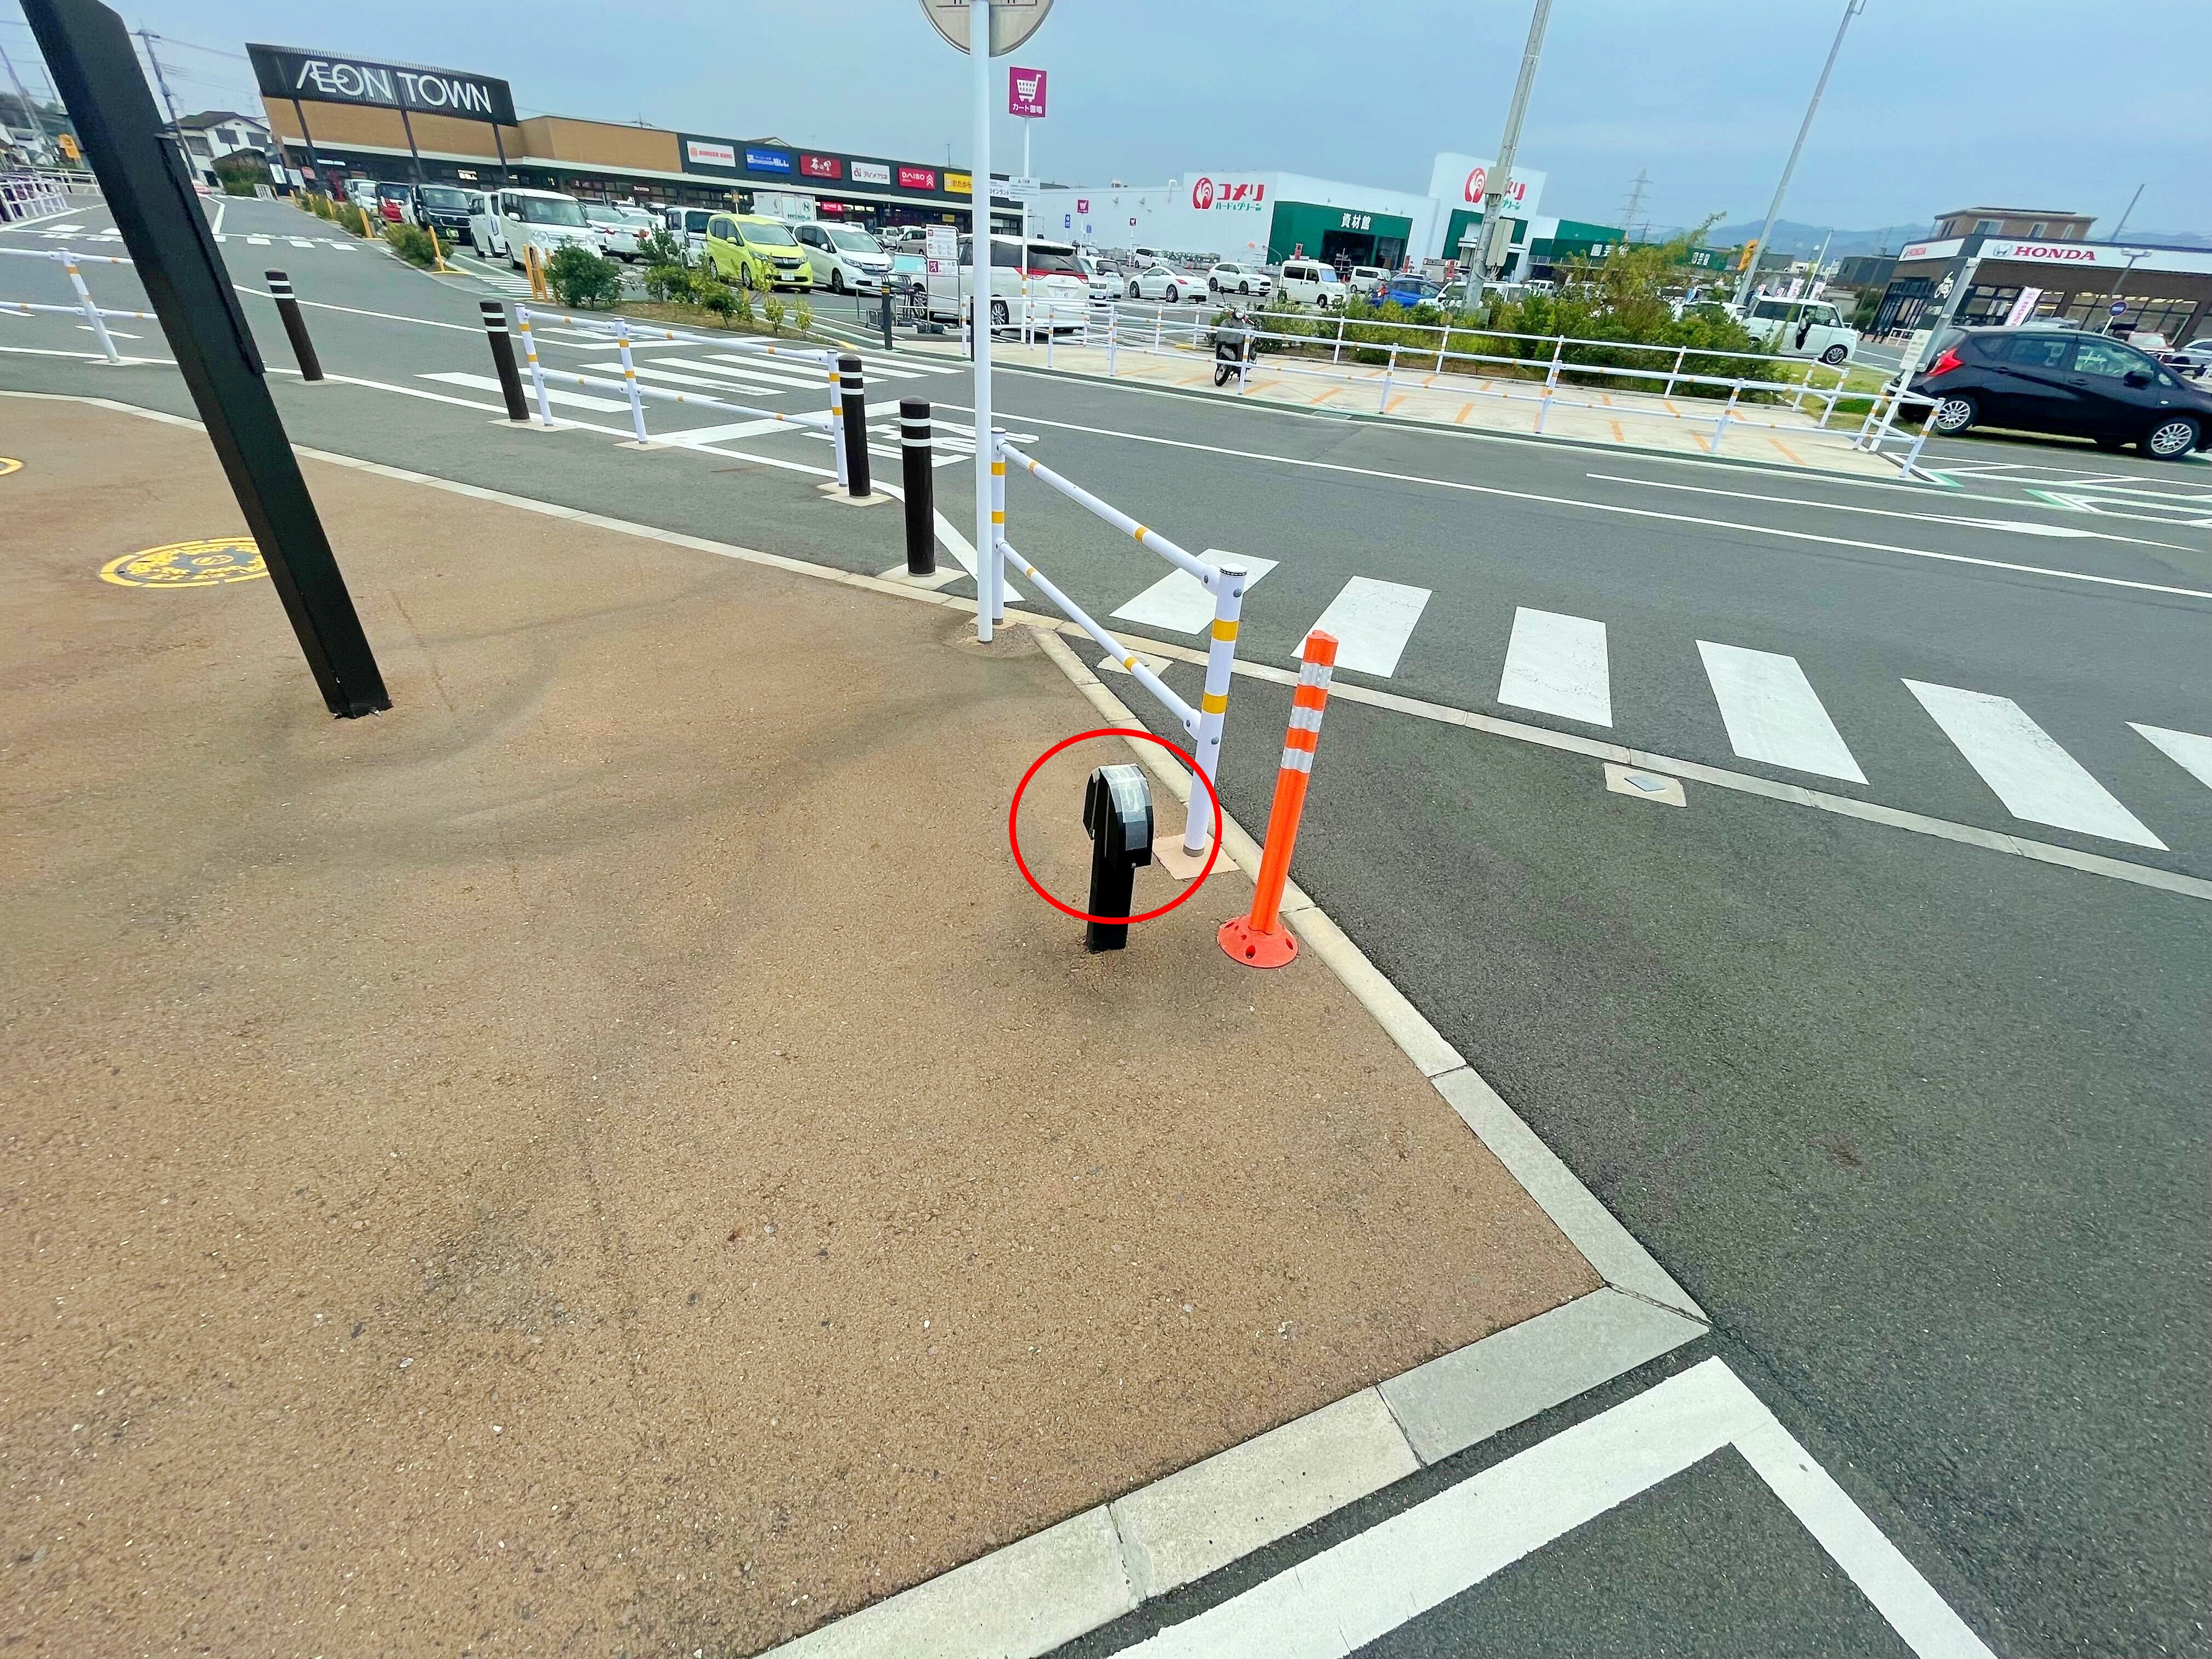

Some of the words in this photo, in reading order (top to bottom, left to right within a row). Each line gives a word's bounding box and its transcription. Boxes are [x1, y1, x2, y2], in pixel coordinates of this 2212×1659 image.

[397, 72, 492, 114] TOWN
[901, 171, 925, 180] DAISO
[1217, 184, 1265, 201] コメリ
[1341, 212, 1371, 230] 資材館
[2013, 246, 2096, 261] HONDA
